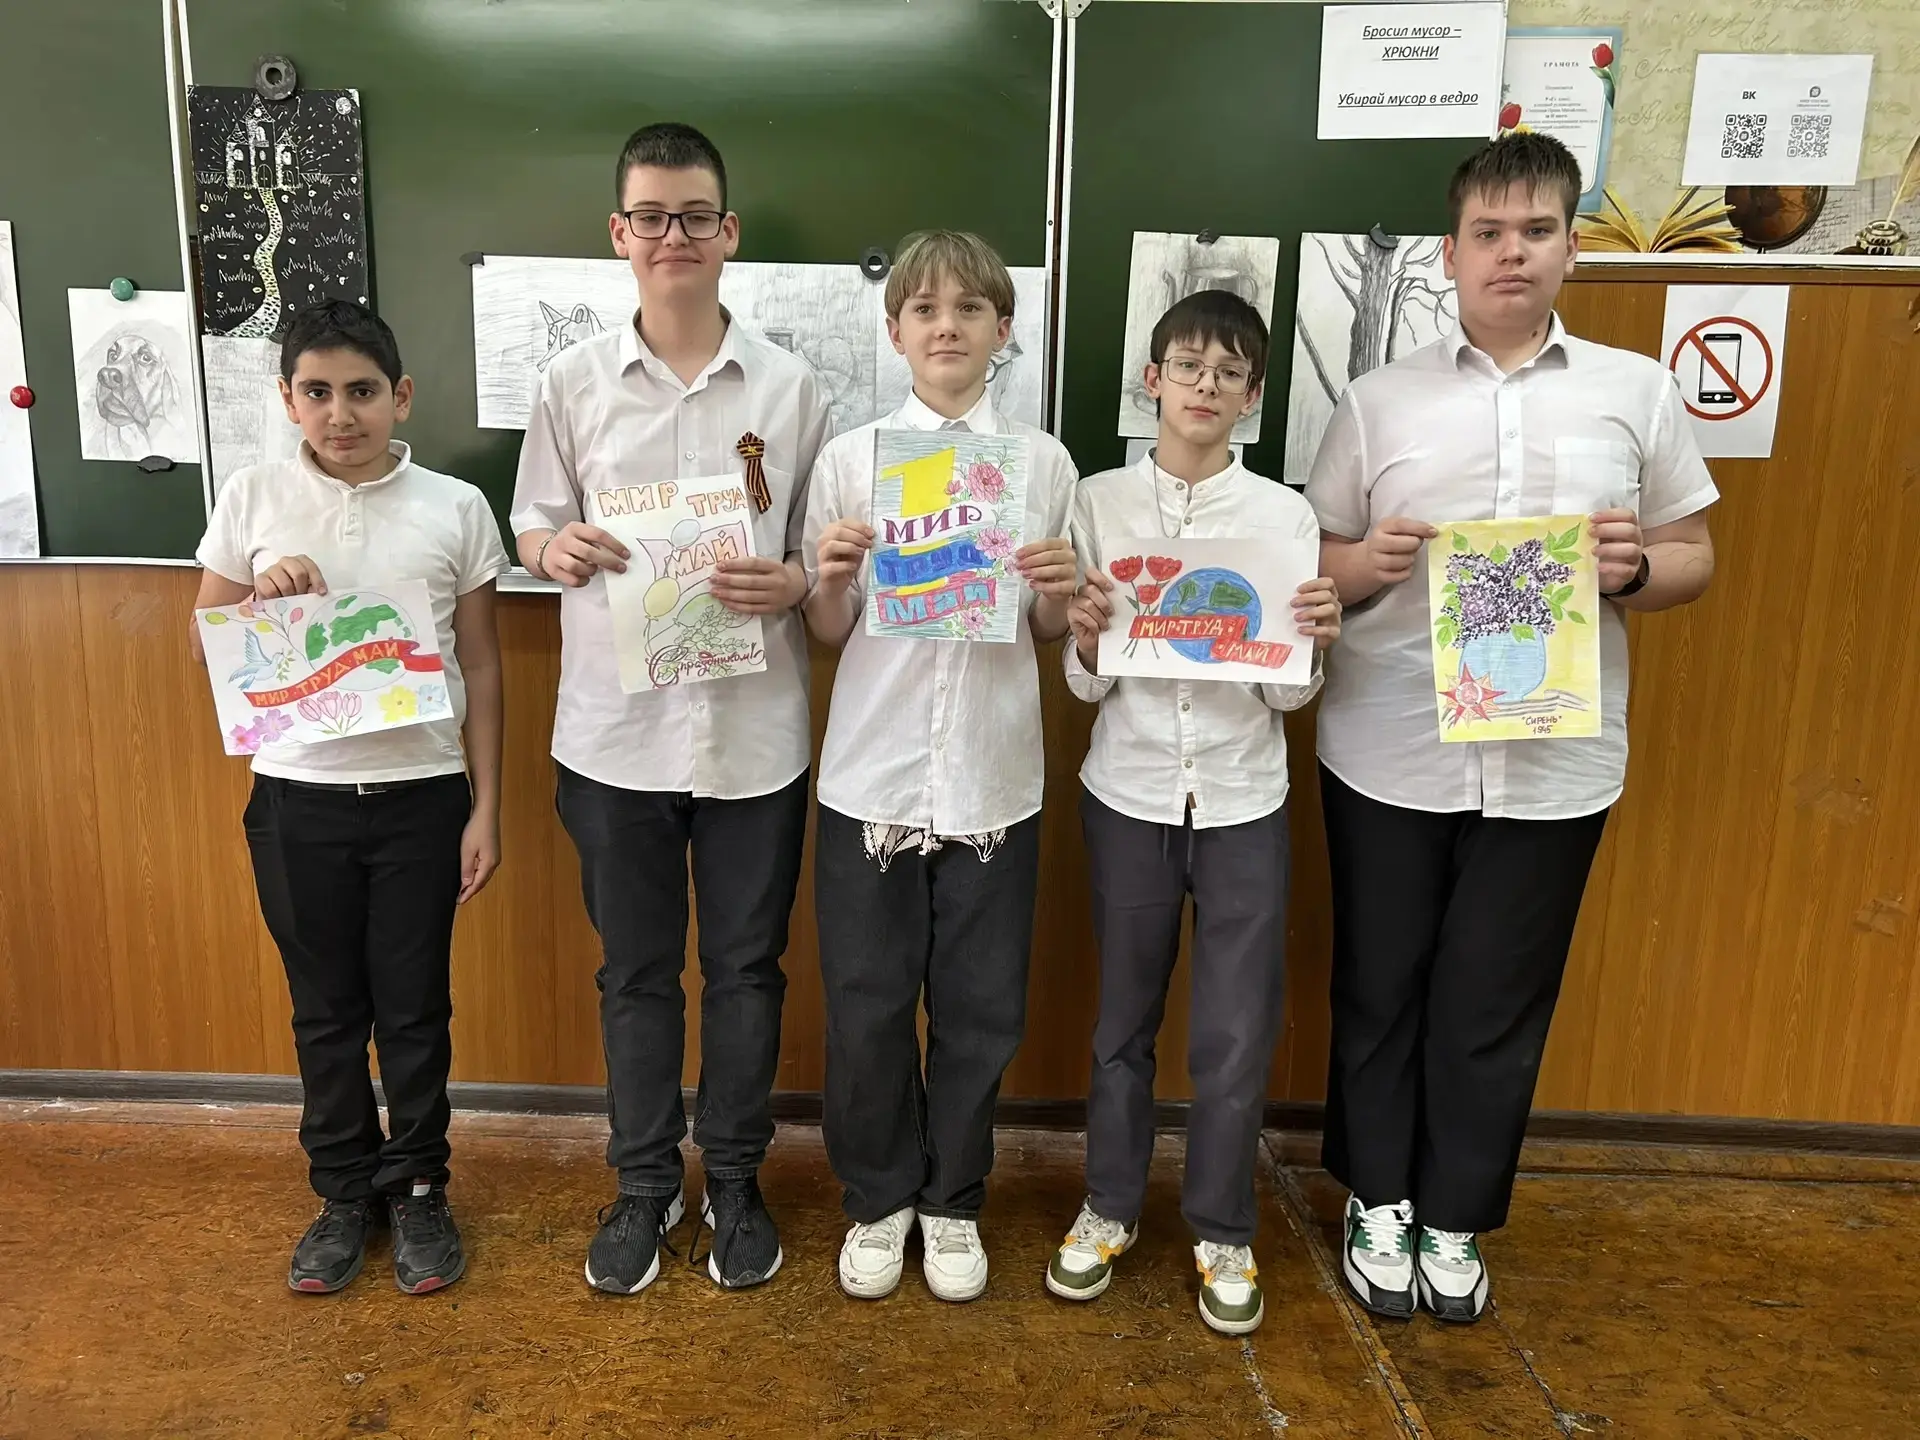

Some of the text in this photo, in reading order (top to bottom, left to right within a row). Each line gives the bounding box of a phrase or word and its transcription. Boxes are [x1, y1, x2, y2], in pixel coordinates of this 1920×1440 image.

[1362, 25, 1408, 39] Бросил
[1411, 26, 1450, 39] мусор
[1382, 46, 1439, 58] ХРЮКНИ
[1338, 91, 1478, 106] Убирай мусор в ведро
[878, 446, 956, 518] 1
[594, 481, 679, 517] МИР
[882, 504, 982, 545] МИР
[663, 530, 738, 580] МАЙ
[1225, 642, 1270, 663] МАЙ
[254, 690, 288, 706] МИР
[296, 661, 349, 696] ТРУД
[1533, 725, 1553, 735] 1945
